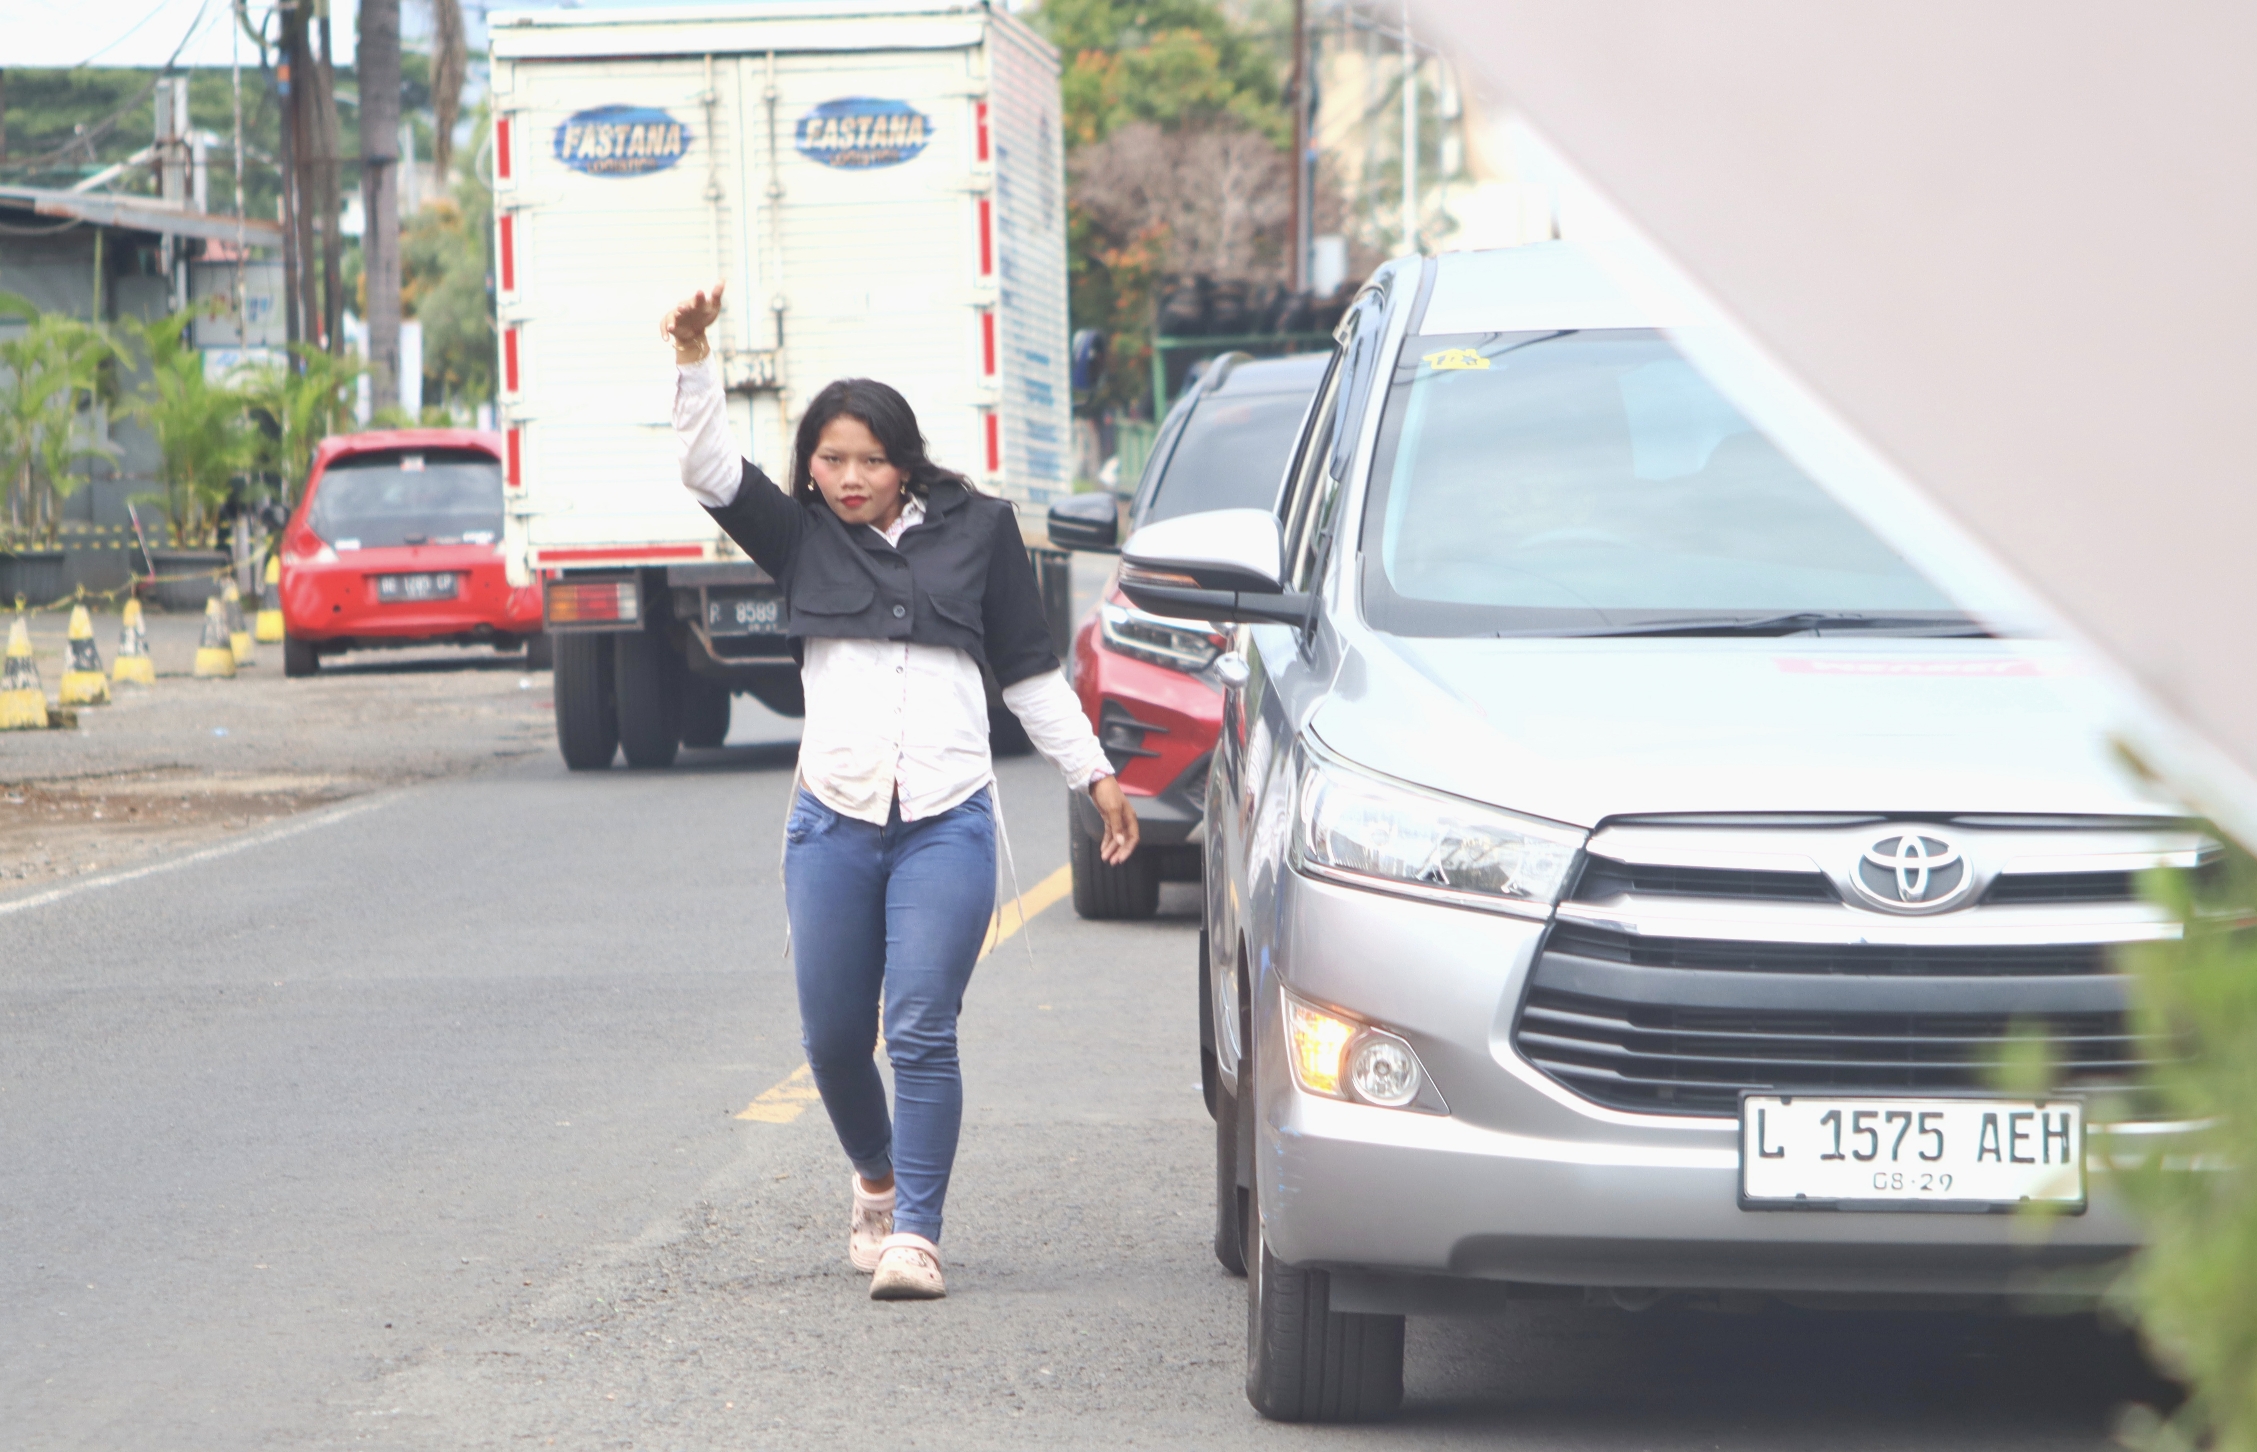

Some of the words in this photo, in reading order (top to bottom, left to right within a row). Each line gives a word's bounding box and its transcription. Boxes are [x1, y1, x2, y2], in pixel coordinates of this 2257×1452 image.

[562, 123, 681, 159] FASTANA
[806, 114, 923, 150] FASTANA
[736, 601, 778, 624] 8589
[1758, 1109, 1785, 1159] L
[1820, 1110, 1945, 1162] 1575
[1977, 1112, 2071, 1164] AEH
